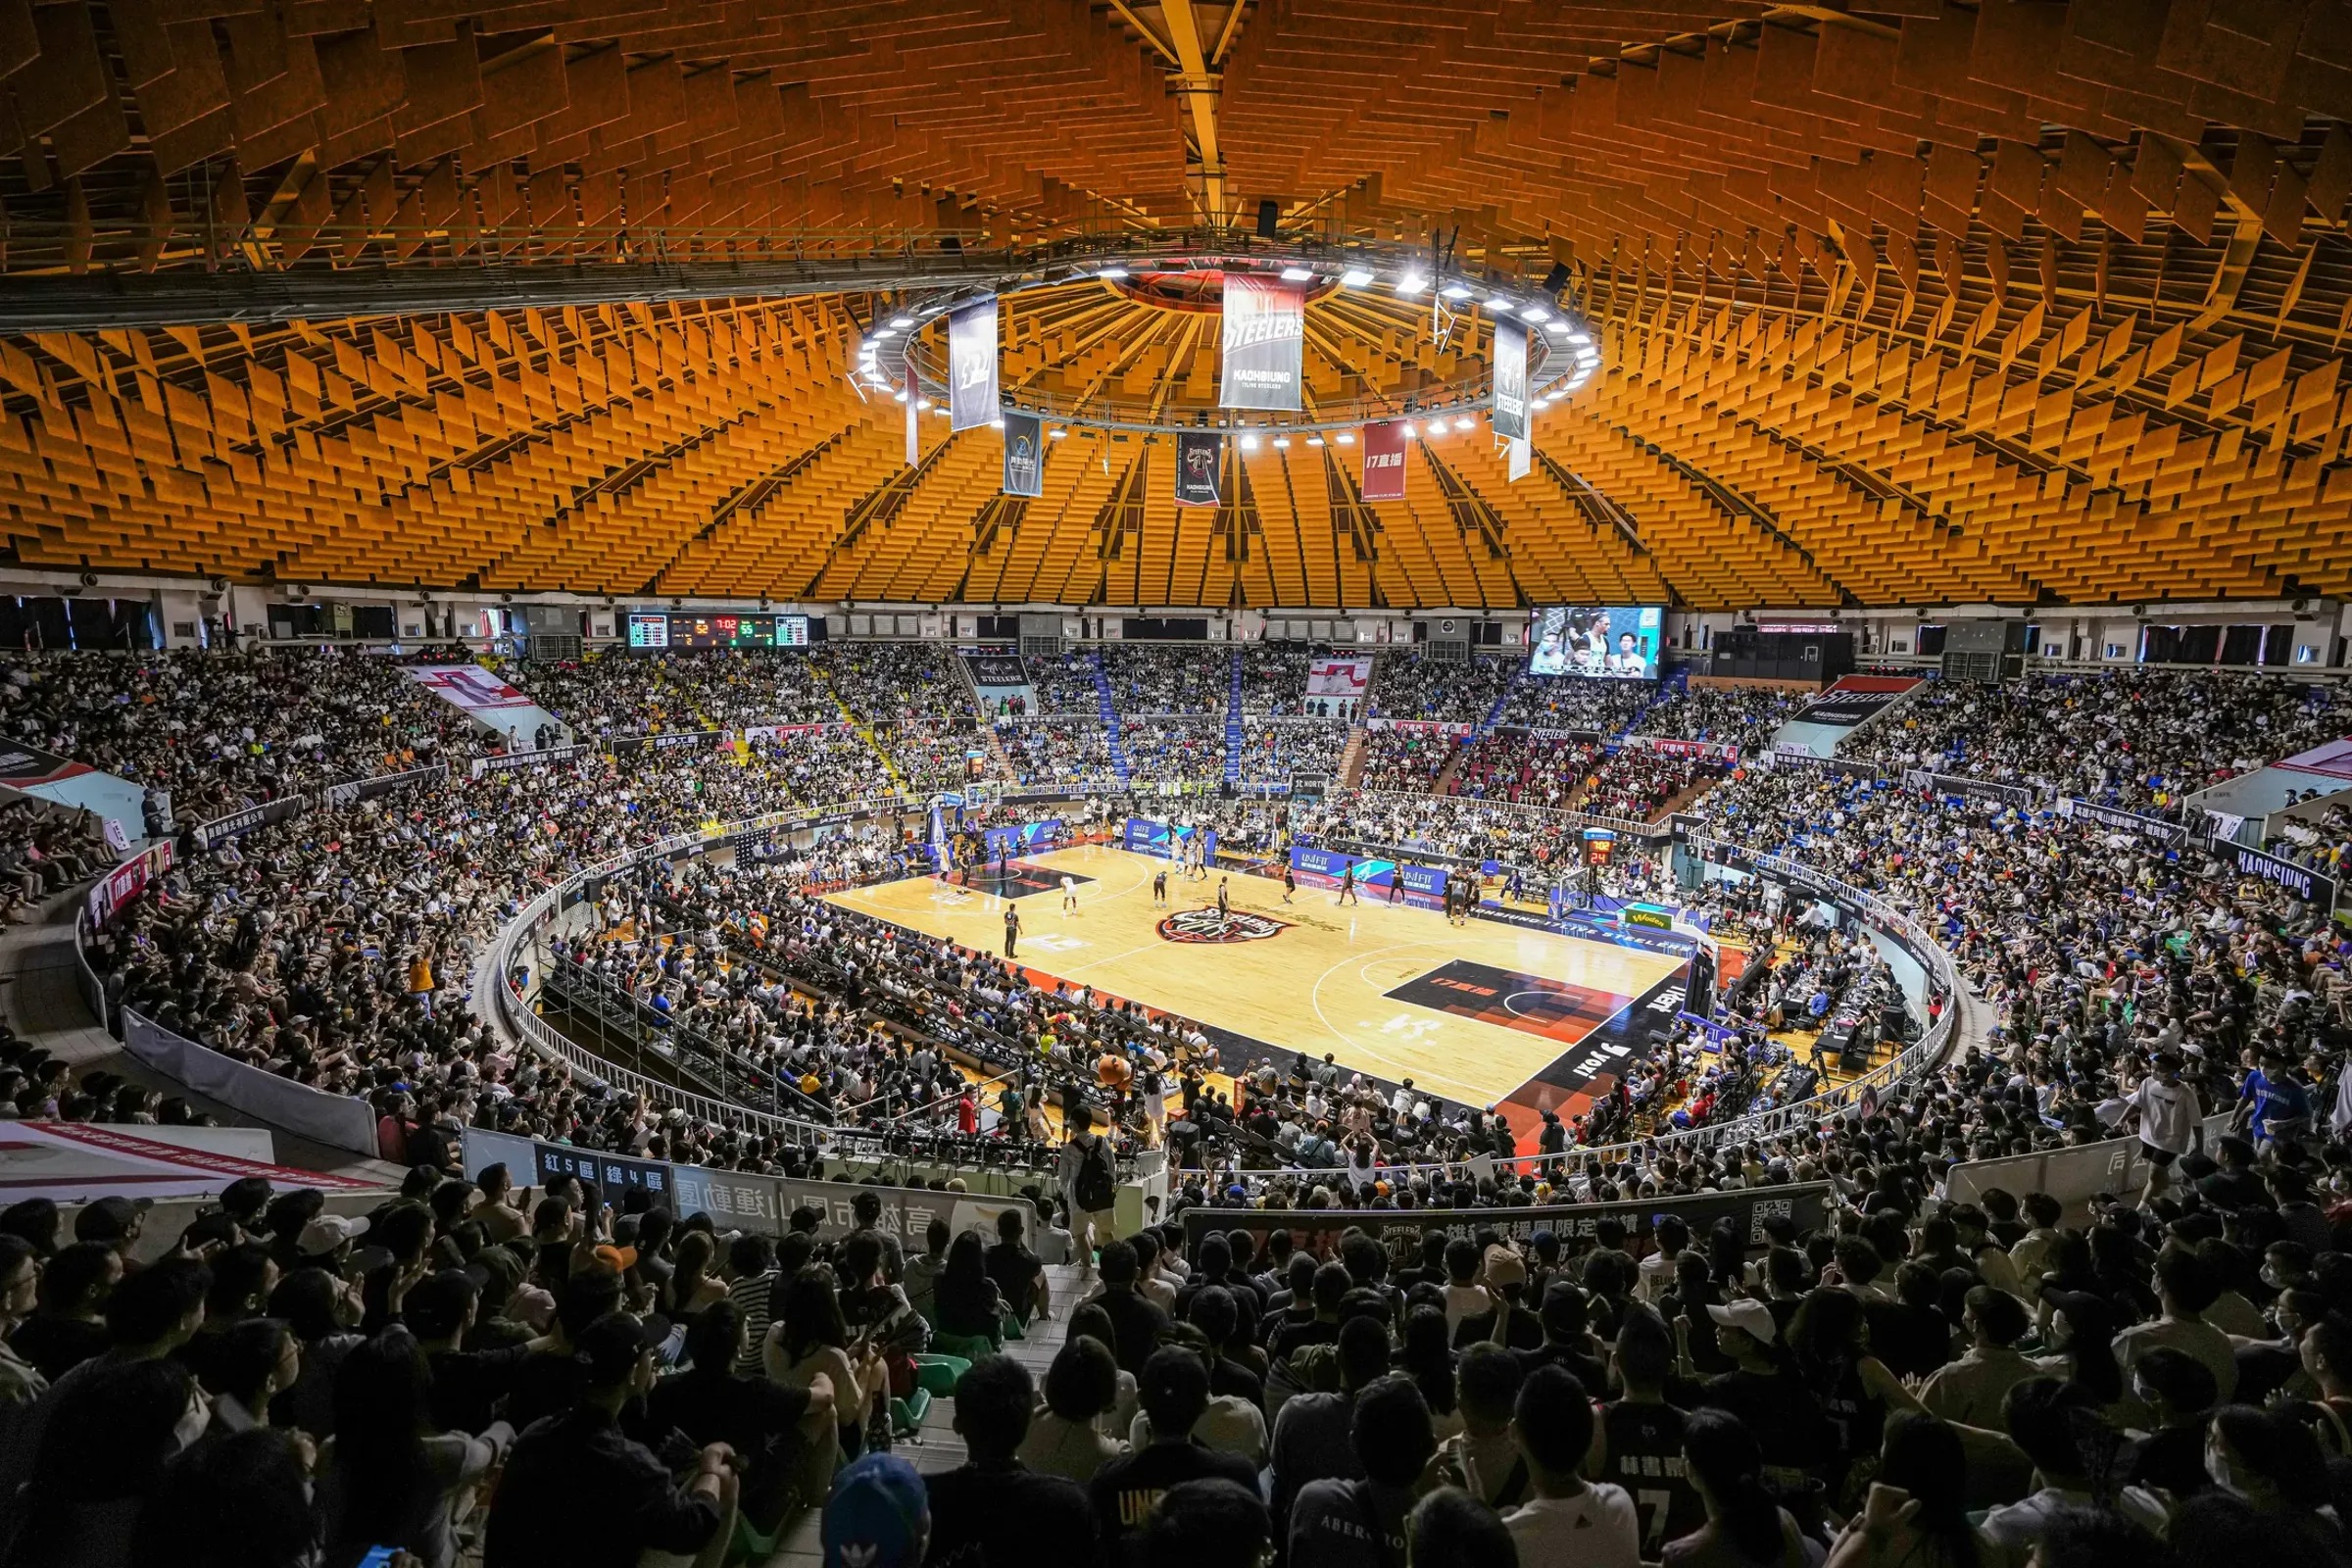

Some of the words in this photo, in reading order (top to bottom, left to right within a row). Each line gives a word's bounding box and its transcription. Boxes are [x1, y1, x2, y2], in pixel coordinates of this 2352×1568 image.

[1366, 452, 1402, 468] 17直播
[696, 624, 709, 635] 52
[716, 619, 736, 629] 7:02
[740, 624, 754, 635] 55
[1591, 853, 1606, 864] 24
[1633, 912, 1665, 928] Woden
